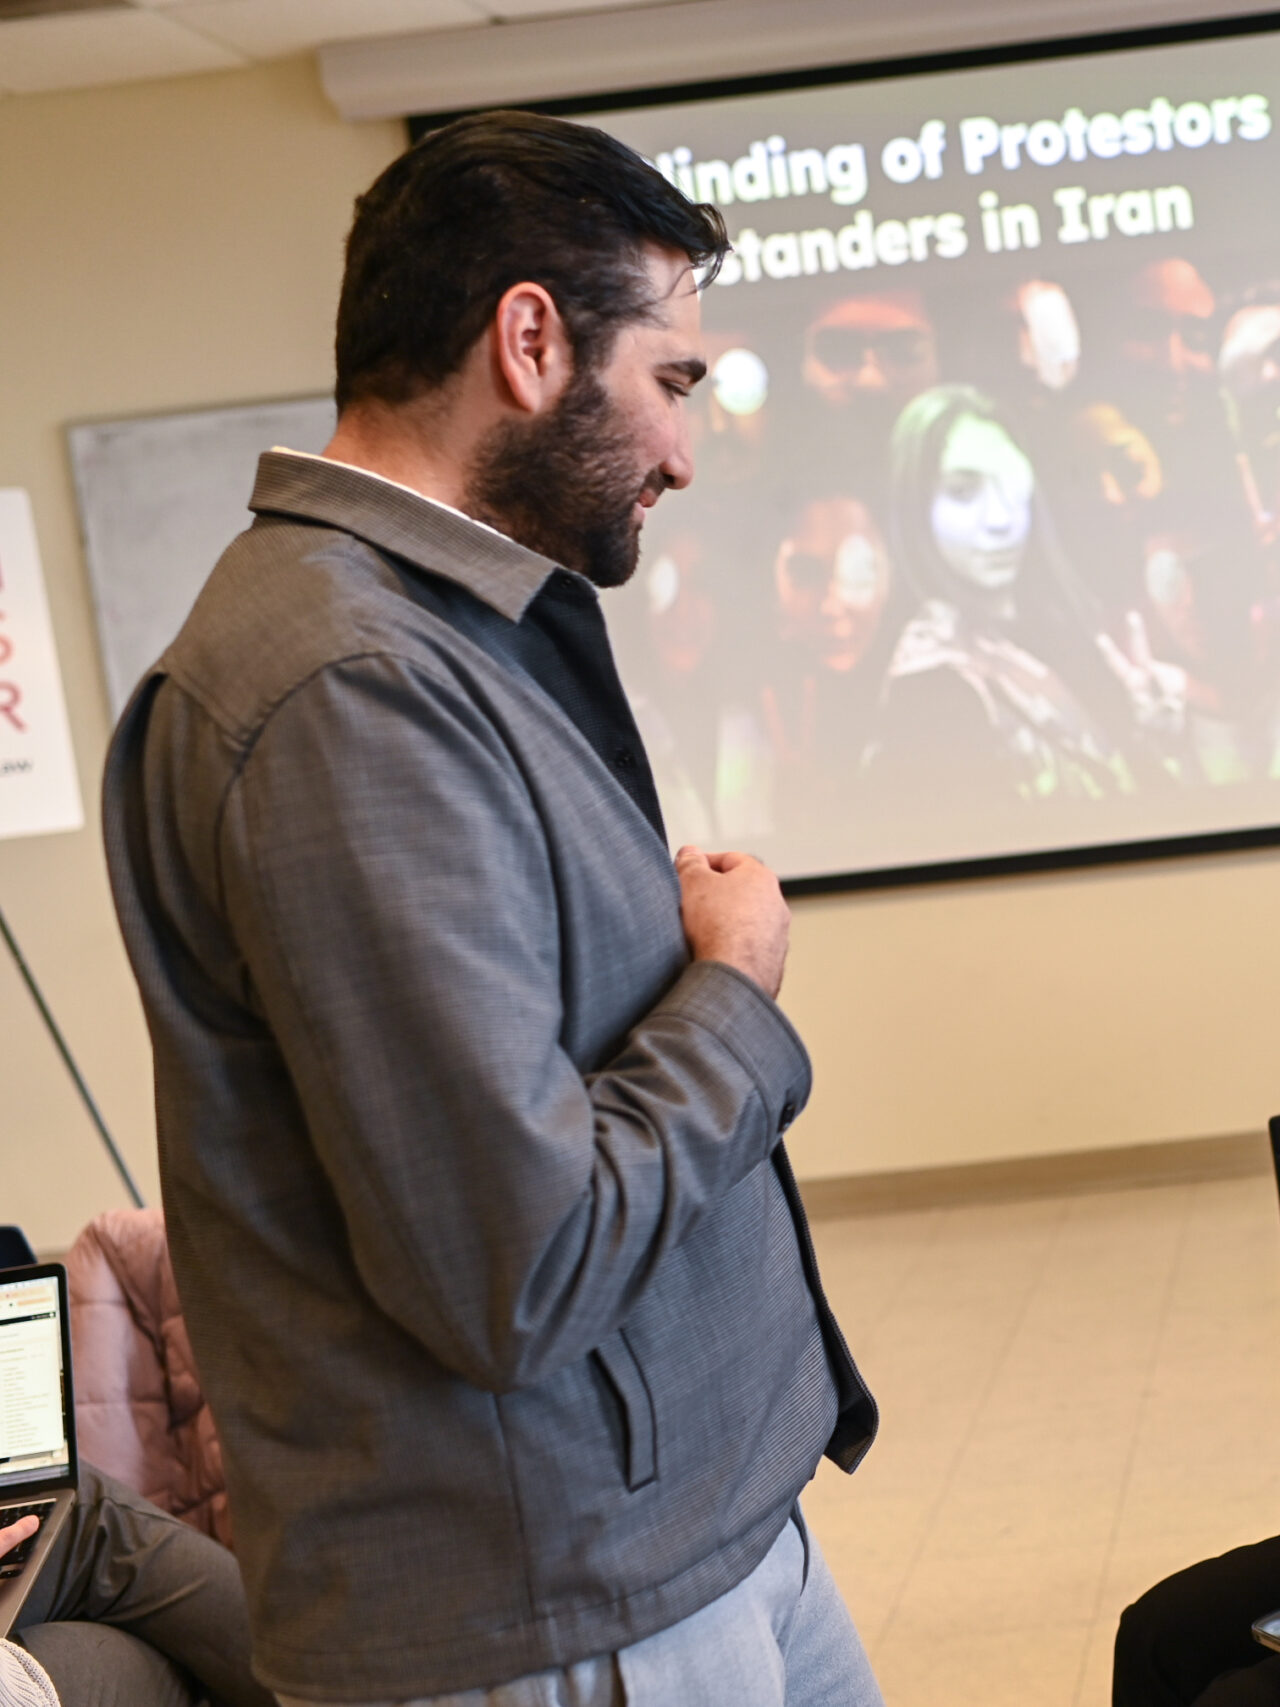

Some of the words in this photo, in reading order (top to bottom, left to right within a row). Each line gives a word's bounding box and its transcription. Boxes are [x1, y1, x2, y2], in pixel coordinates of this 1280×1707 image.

[650, 135, 867, 205] linding
[881, 119, 946, 180] of
[959, 94, 1271, 175] Protestors
[712, 209, 968, 286] standers
[978, 190, 1041, 253] in
[1053, 185, 1194, 244] Iran
